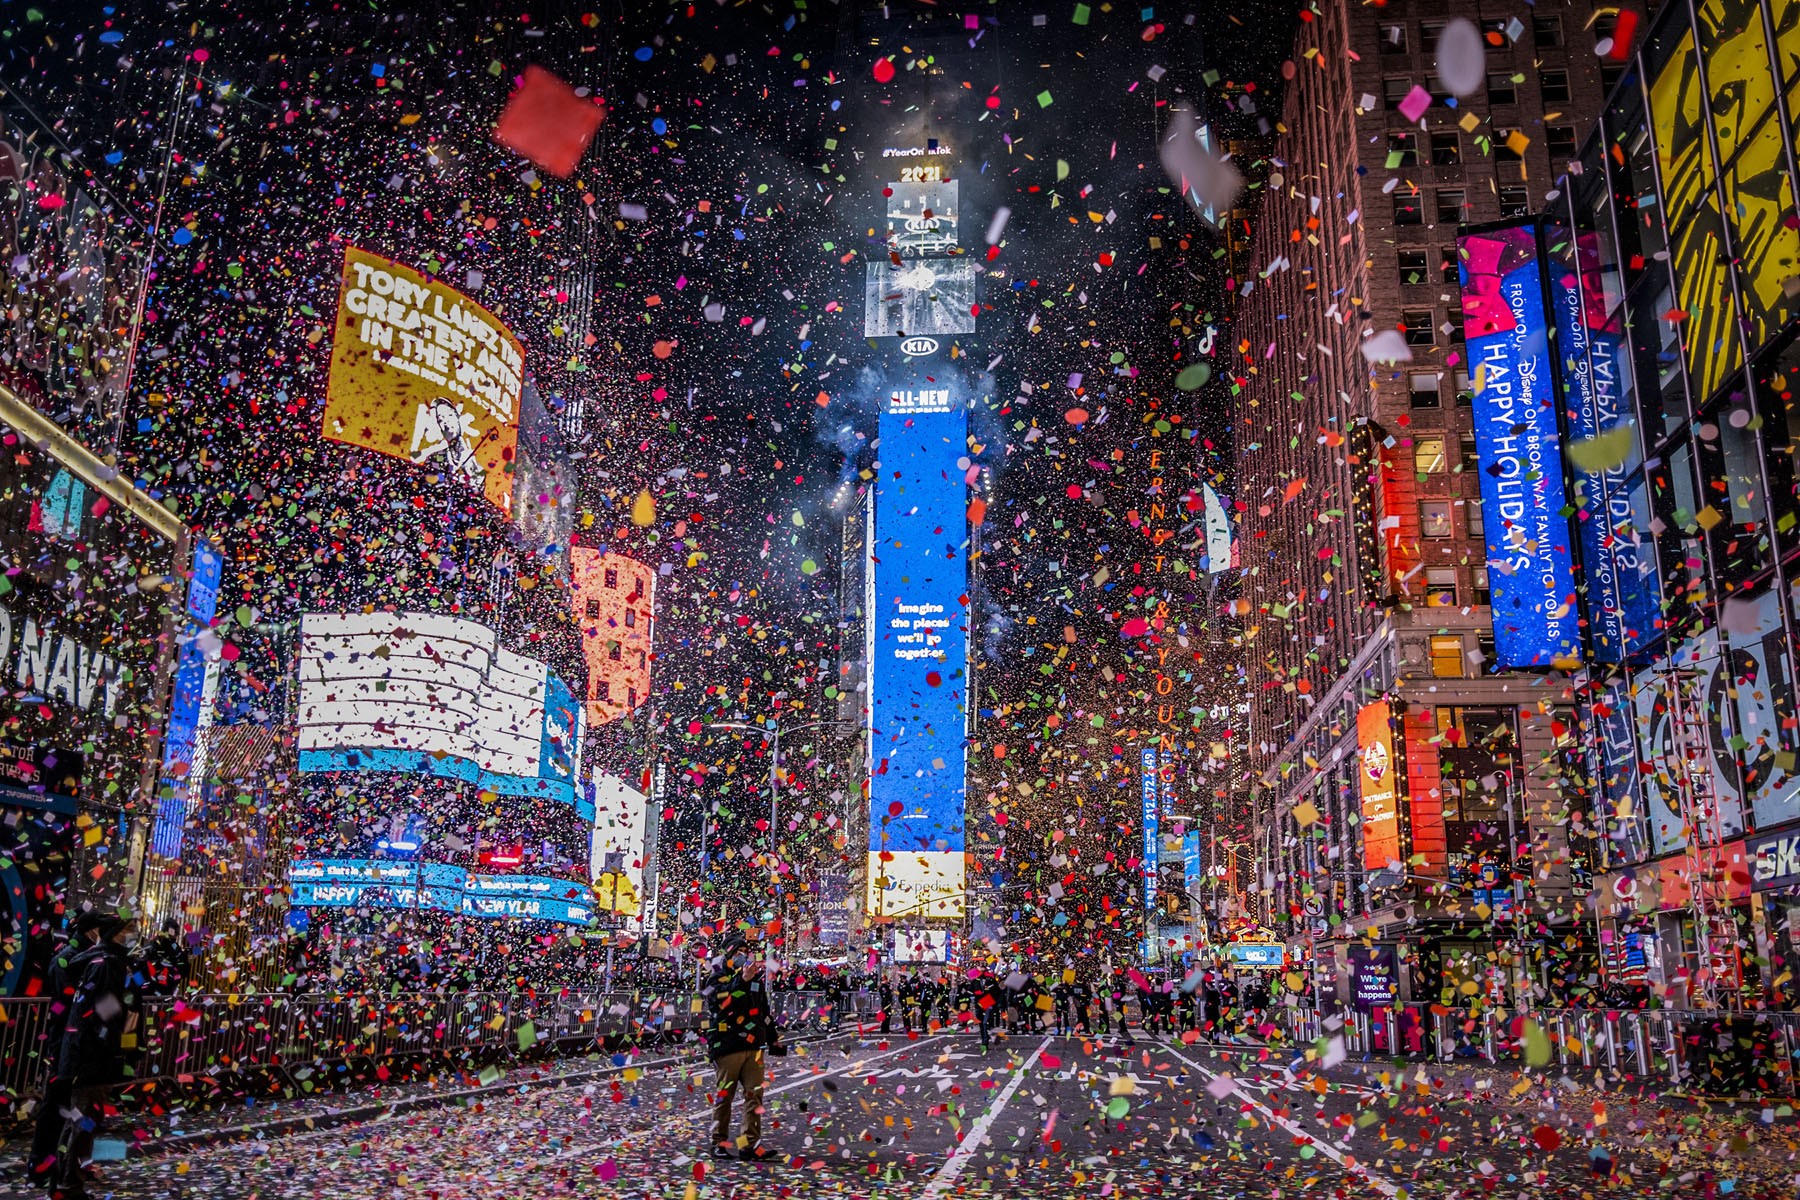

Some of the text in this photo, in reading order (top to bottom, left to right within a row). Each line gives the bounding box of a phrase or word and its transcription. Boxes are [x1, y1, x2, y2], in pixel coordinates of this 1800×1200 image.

[901, 166, 941, 183] 2021
[353, 262, 431, 309] TORY
[434, 296, 499, 353] LANEZ
[1511, 283, 1526, 323] FROM
[346, 289, 476, 360] GREATEST
[1514, 324, 1528, 351] OU
[360, 319, 393, 350] IN
[398, 331, 450, 374] THE
[907, 341, 933, 352] KIA
[890, 390, 949, 407] ALL-NEW
[1484, 344, 1515, 426] HAPPY
[1525, 409, 1538, 430] ON
[1536, 515, 1552, 562] FAMILY
[891, 618, 950, 631] the places
[897, 633, 942, 645] we'll go
[17, 617, 128, 719] NAVY
[1358, 990, 1392, 1000] happens
